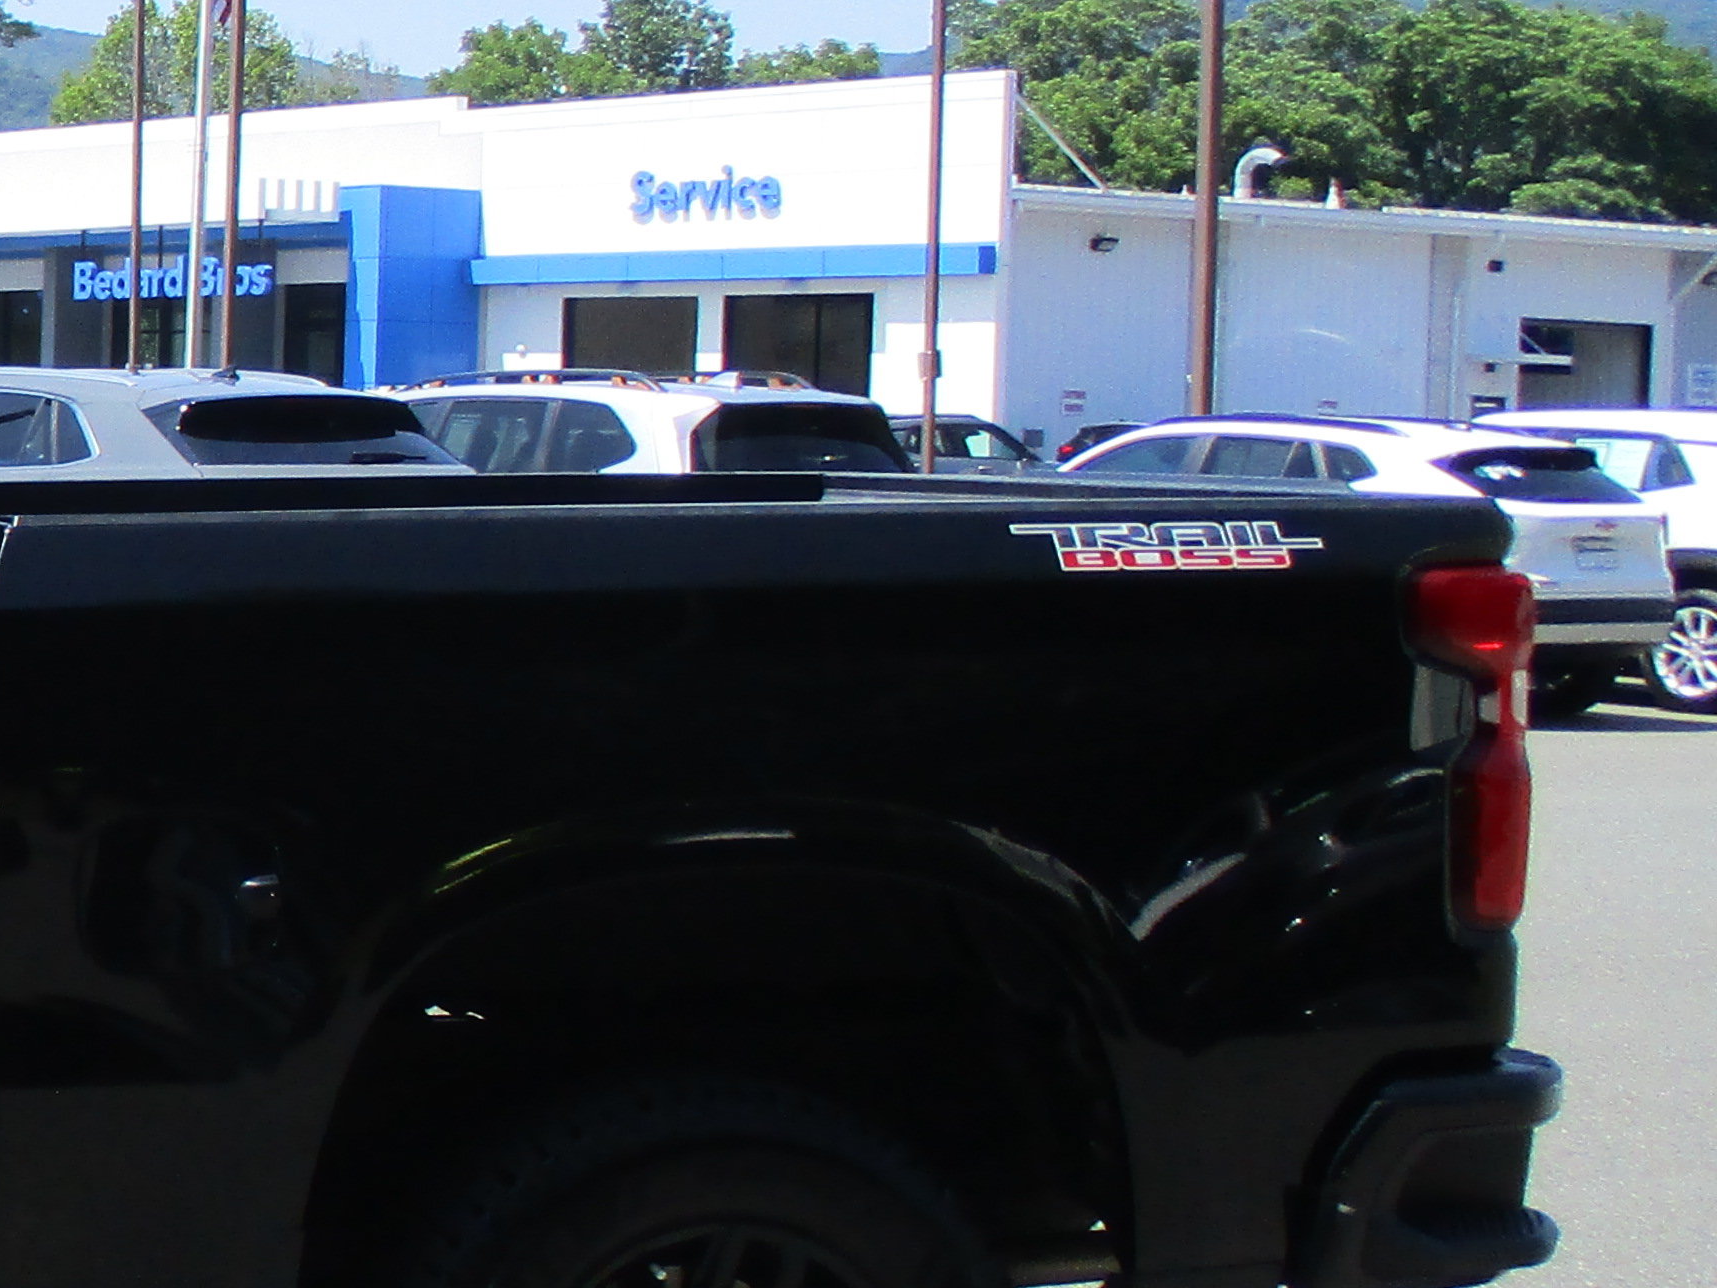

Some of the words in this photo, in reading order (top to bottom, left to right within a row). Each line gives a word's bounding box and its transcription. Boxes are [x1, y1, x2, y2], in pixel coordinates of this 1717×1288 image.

[630, 165, 781, 224] Service
[1009, 521, 1324, 549] TRAIL
[1060, 547, 1293, 571] BOSS
